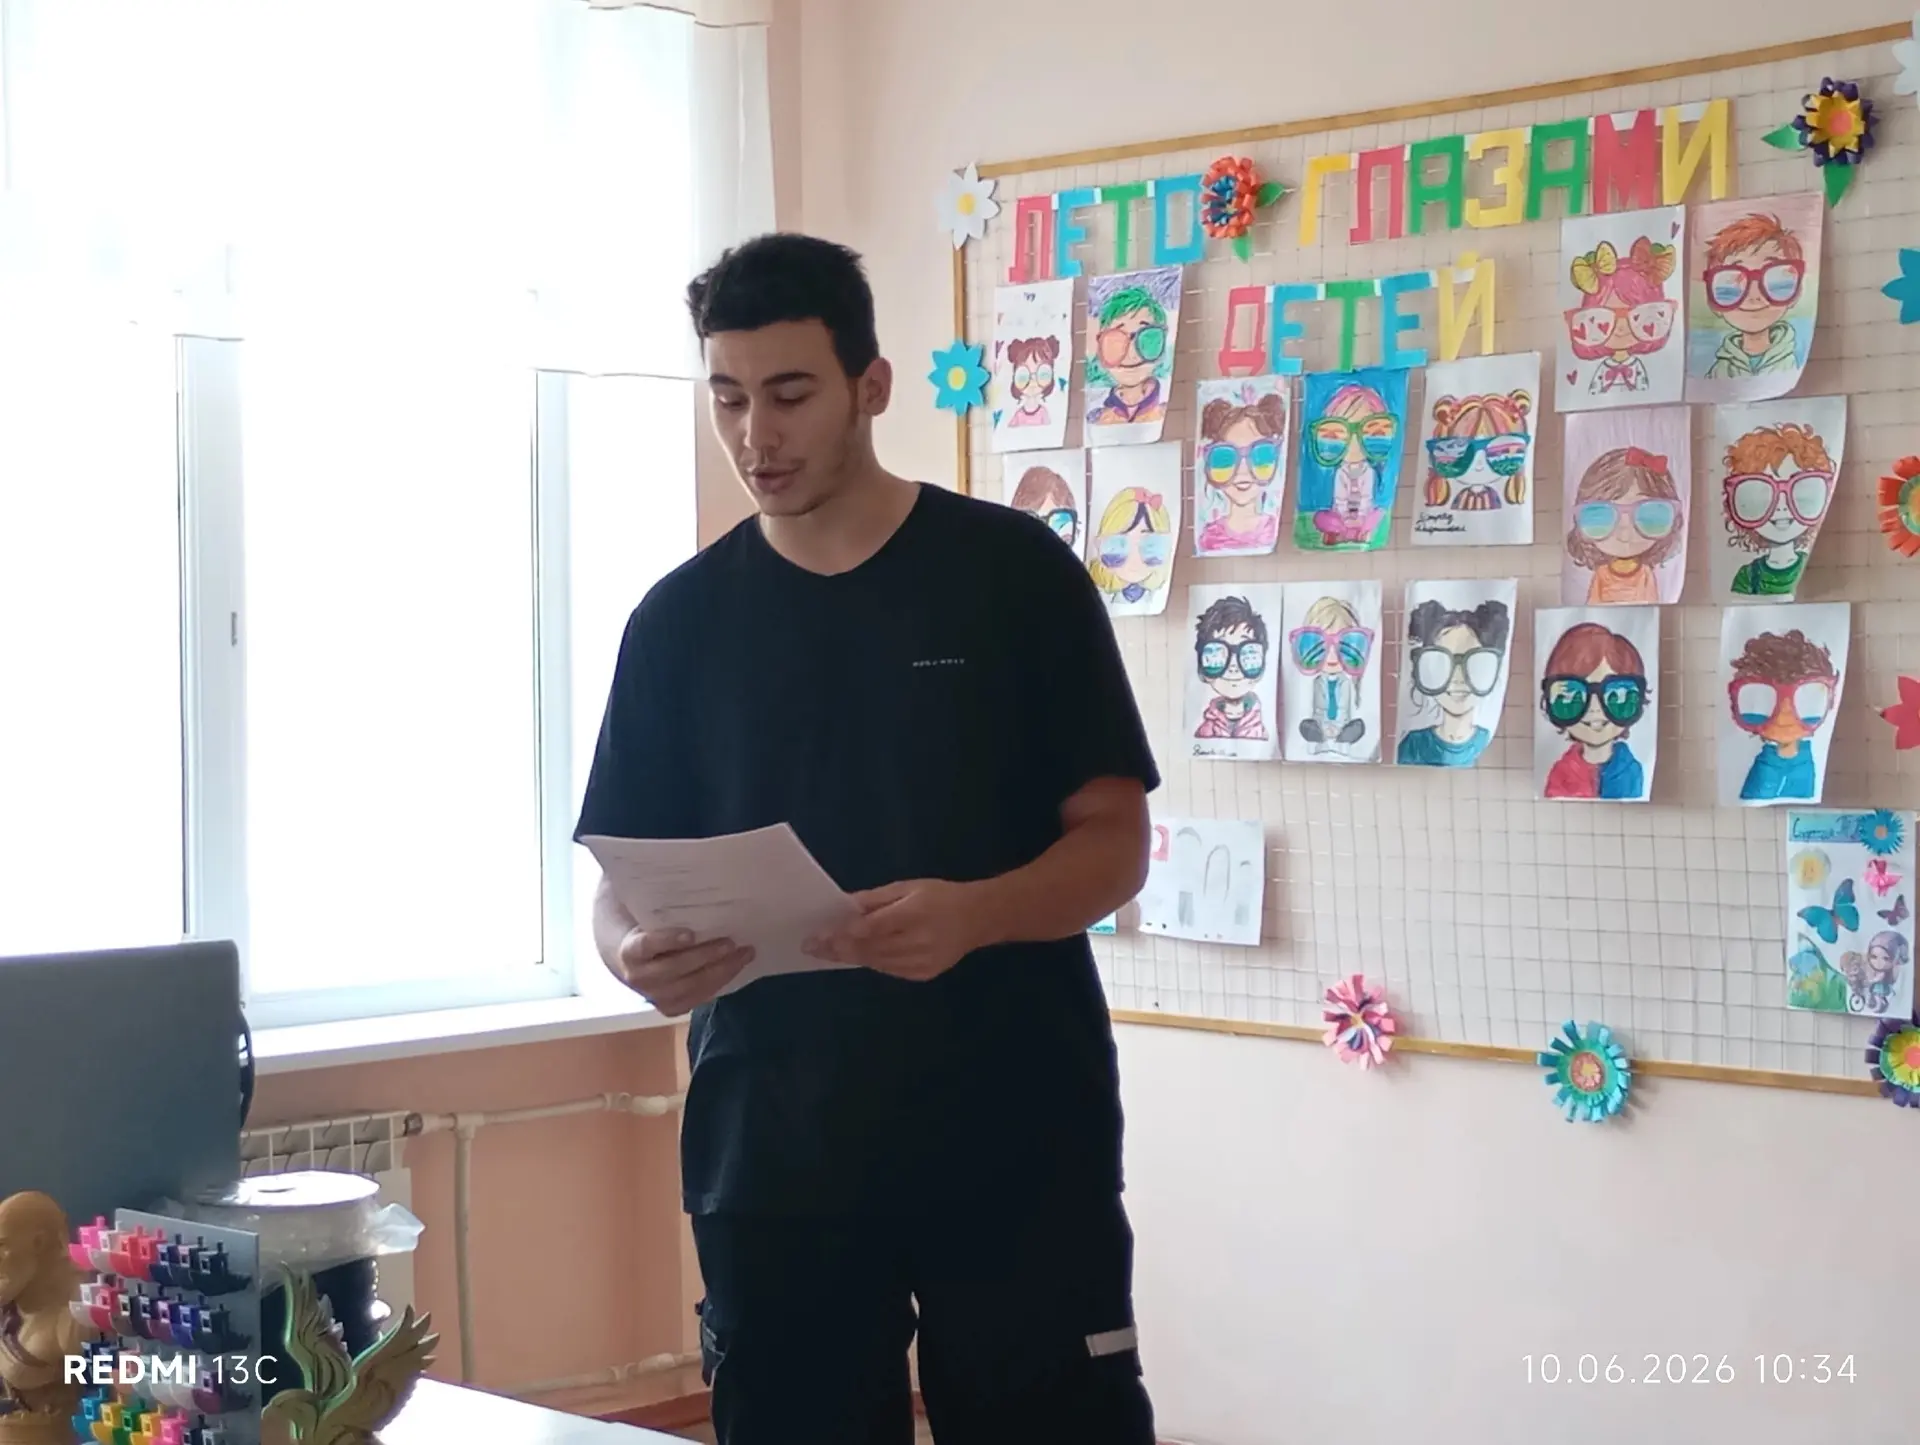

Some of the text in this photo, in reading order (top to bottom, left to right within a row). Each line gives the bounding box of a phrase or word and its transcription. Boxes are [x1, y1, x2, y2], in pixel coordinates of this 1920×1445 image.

[1009, 99, 1729, 283] ЛЕТО ГЛАЗАМИ
[1218, 251, 1495, 376] ДЕТЕЙ
